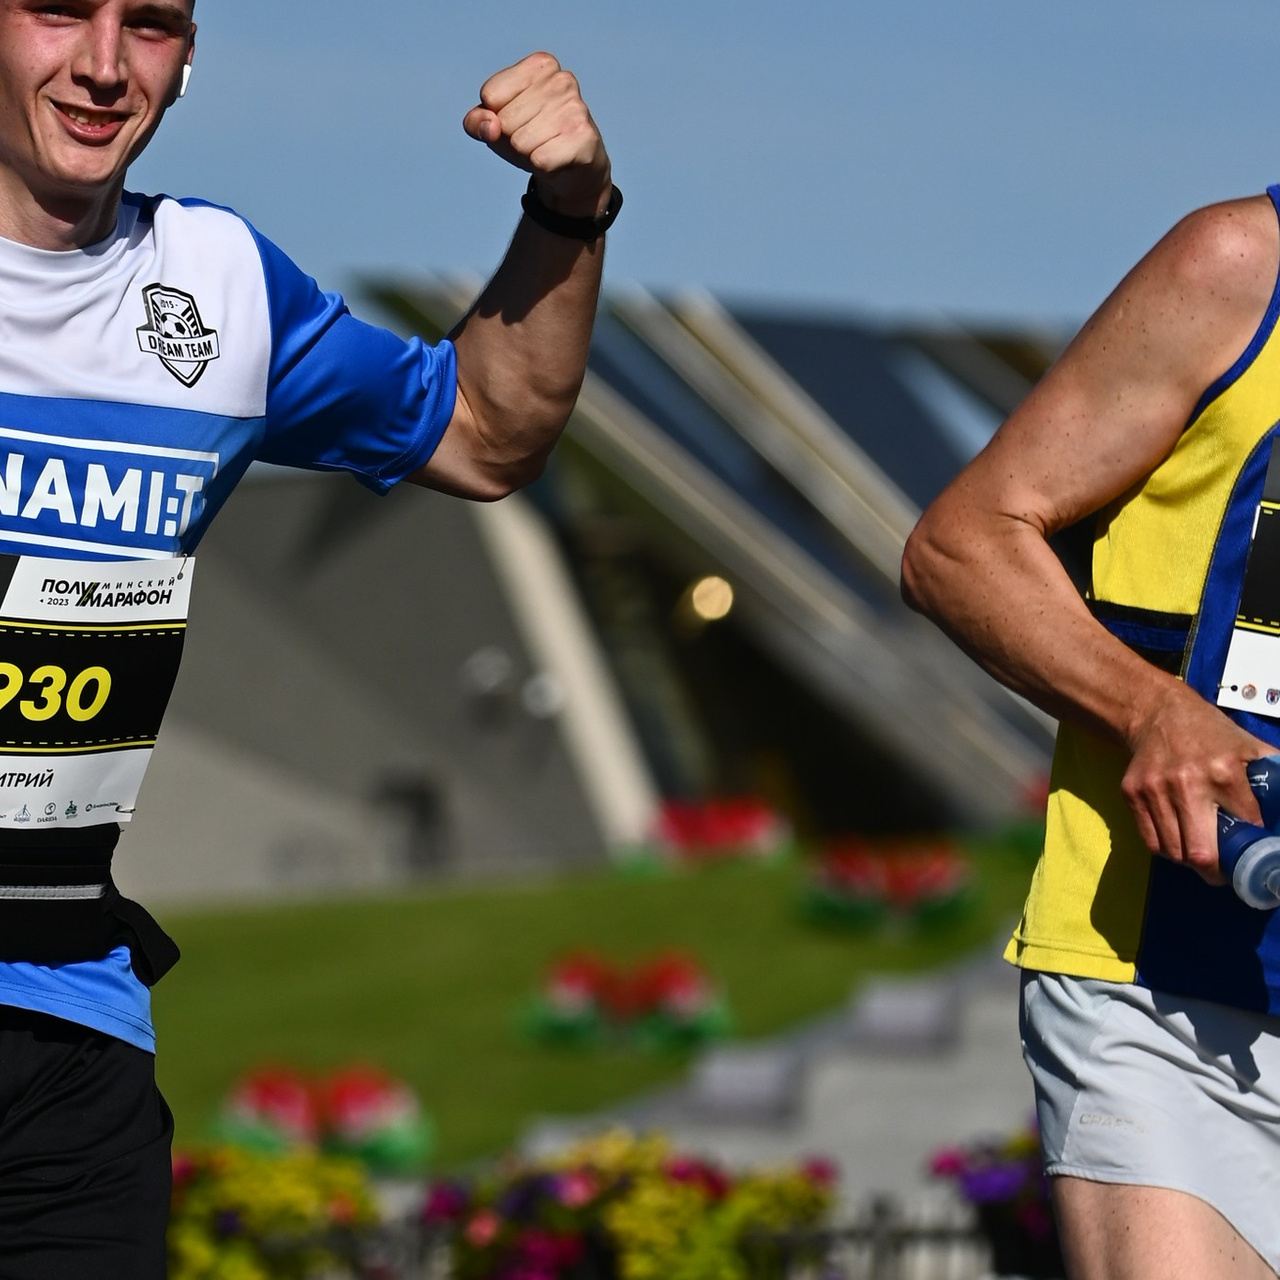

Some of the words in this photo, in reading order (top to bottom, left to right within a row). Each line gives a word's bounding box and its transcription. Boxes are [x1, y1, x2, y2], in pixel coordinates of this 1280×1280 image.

[184, 340, 213, 358] TEAM
[102, 577, 175, 590] МИНСКИЙ
[47, 598, 69, 606] 2023
[84, 589, 172, 607] МАРАФОН
